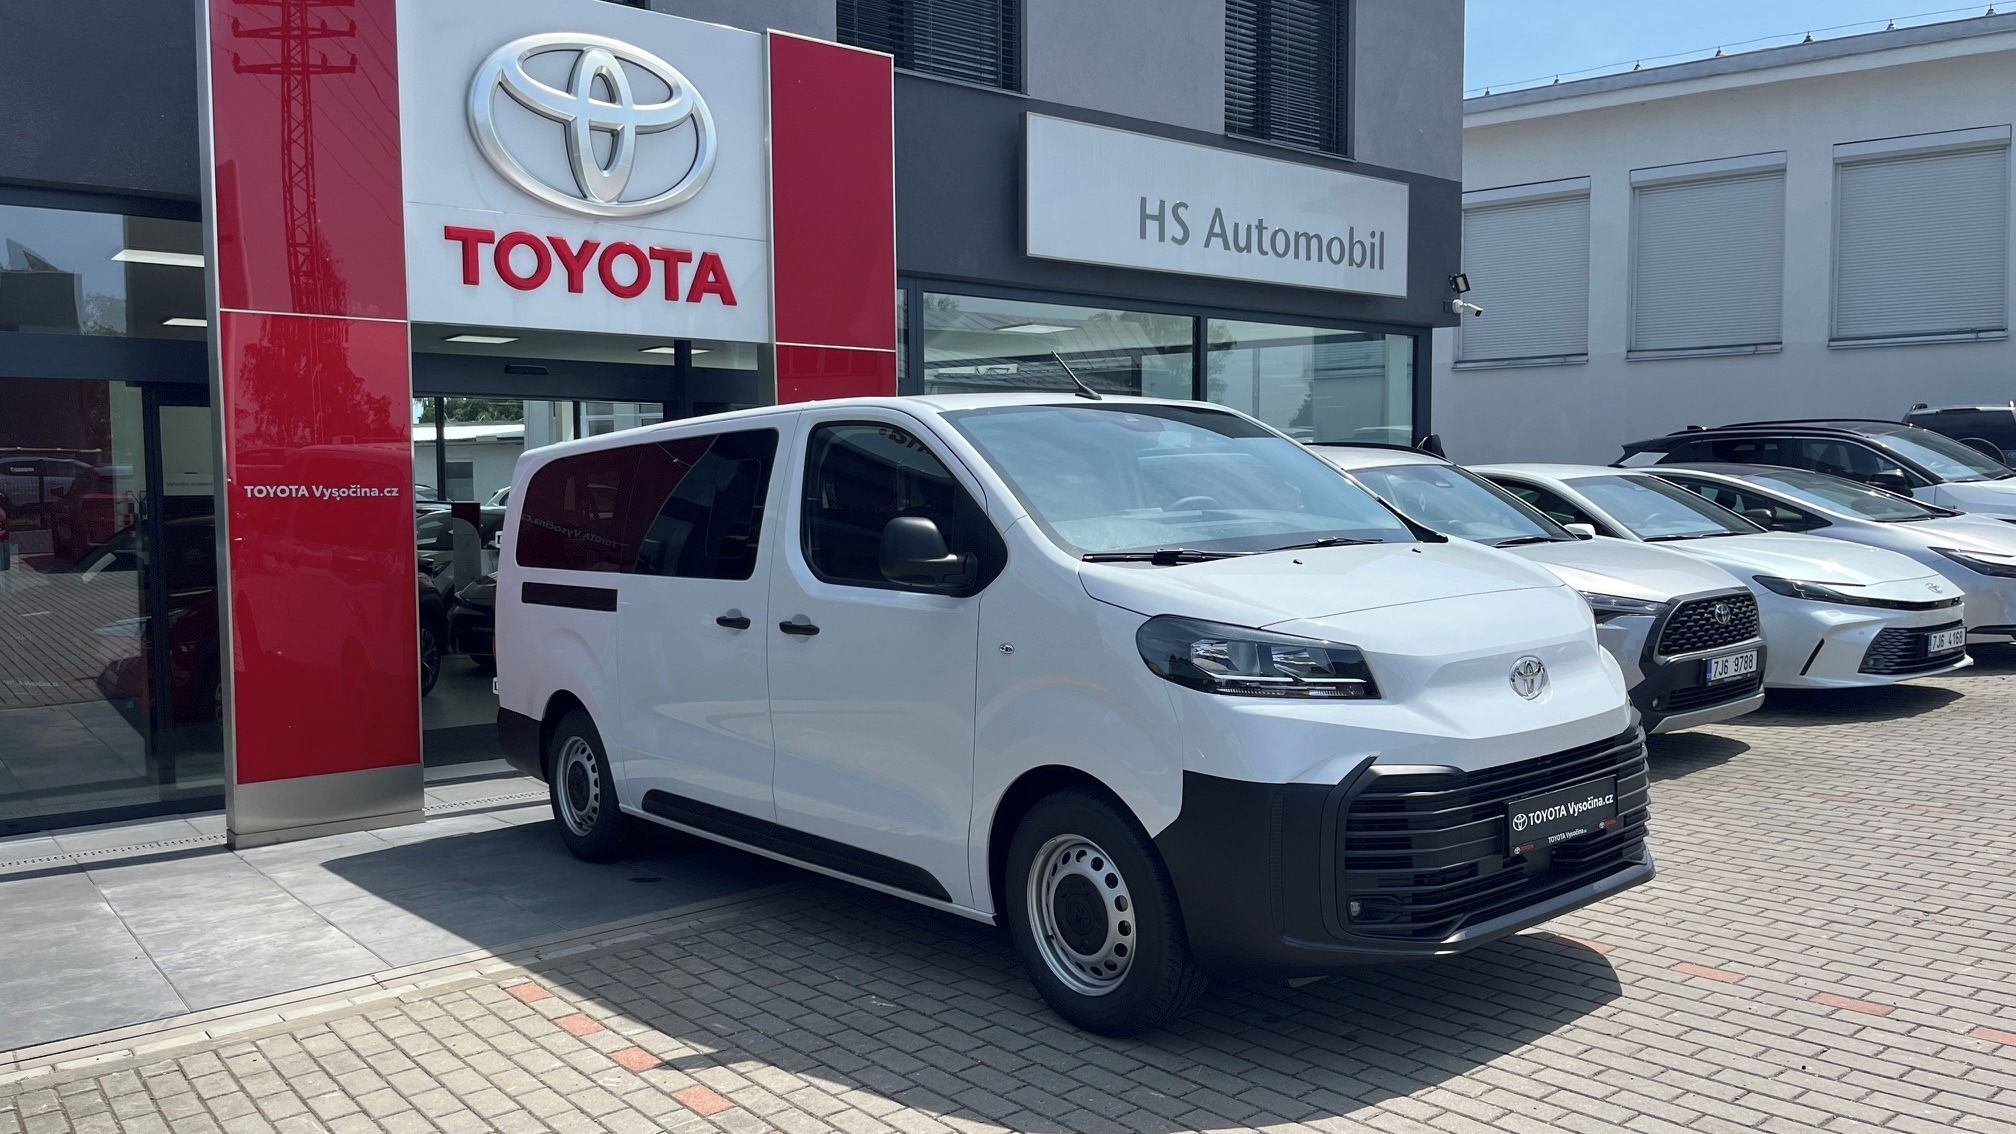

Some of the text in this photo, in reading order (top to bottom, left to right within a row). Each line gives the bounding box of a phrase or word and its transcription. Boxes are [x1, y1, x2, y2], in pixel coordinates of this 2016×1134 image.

[1140, 196, 1385, 270] HS Automobil
[444, 225, 738, 306] TOYOTA
[244, 484, 399, 500] TOYOTA Vysočina.cz
[1932, 634, 1945, 650] 7J6
[1713, 654, 1754, 678] 7J6 9788
[1528, 794, 1614, 826] TOYOTA Vysočina.cz
[1548, 832, 1565, 844] TOYOTA
